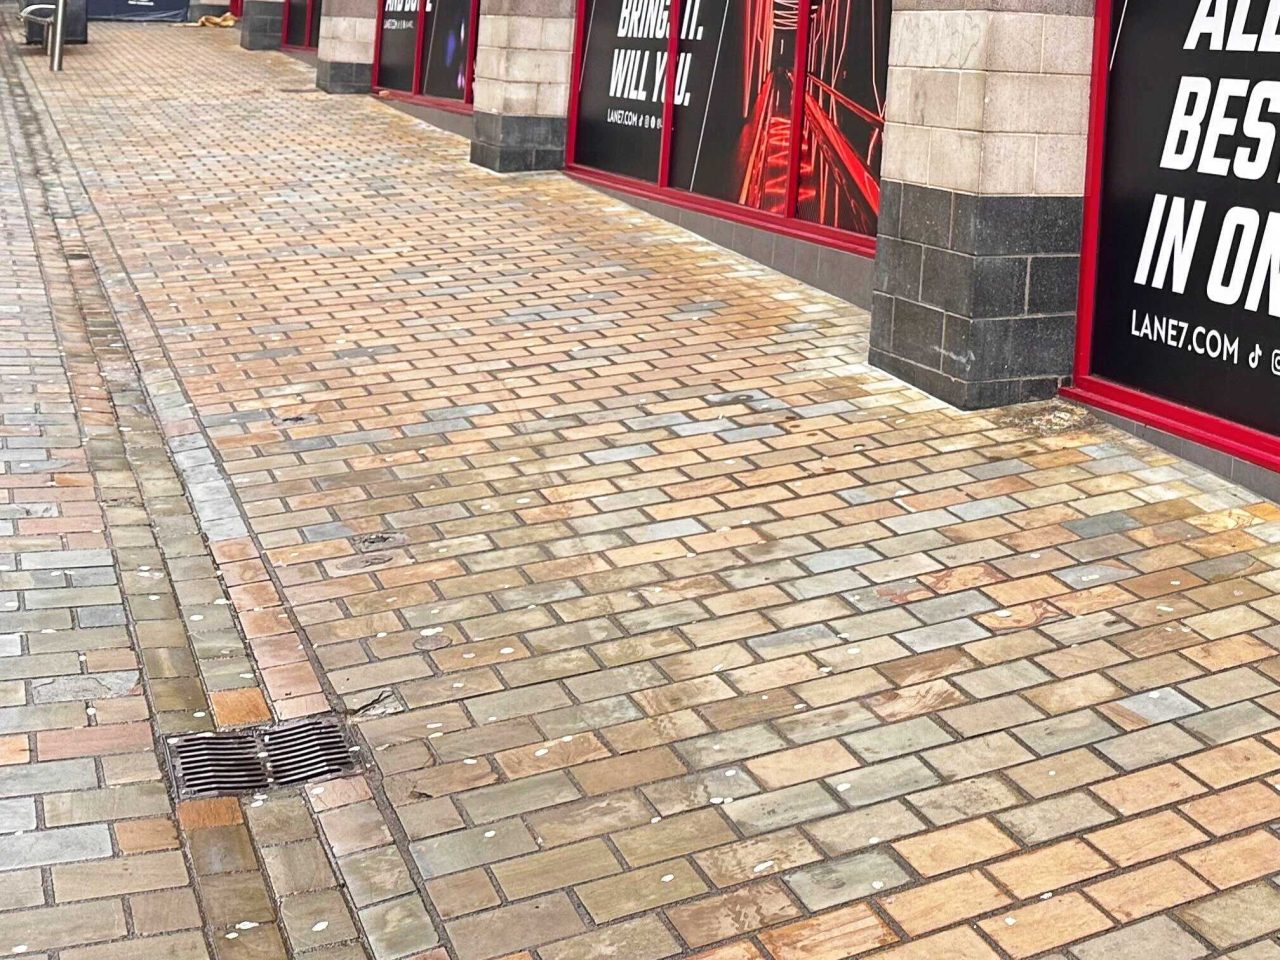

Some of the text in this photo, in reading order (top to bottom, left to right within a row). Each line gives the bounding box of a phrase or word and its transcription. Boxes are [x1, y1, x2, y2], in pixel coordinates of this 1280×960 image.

[609, 48, 692, 106] WILL YU.
[607, 108, 638, 126] LANE7.COM
[1133, 193, 1206, 295] IN
[1131, 309, 1239, 365] LANE7.COM
